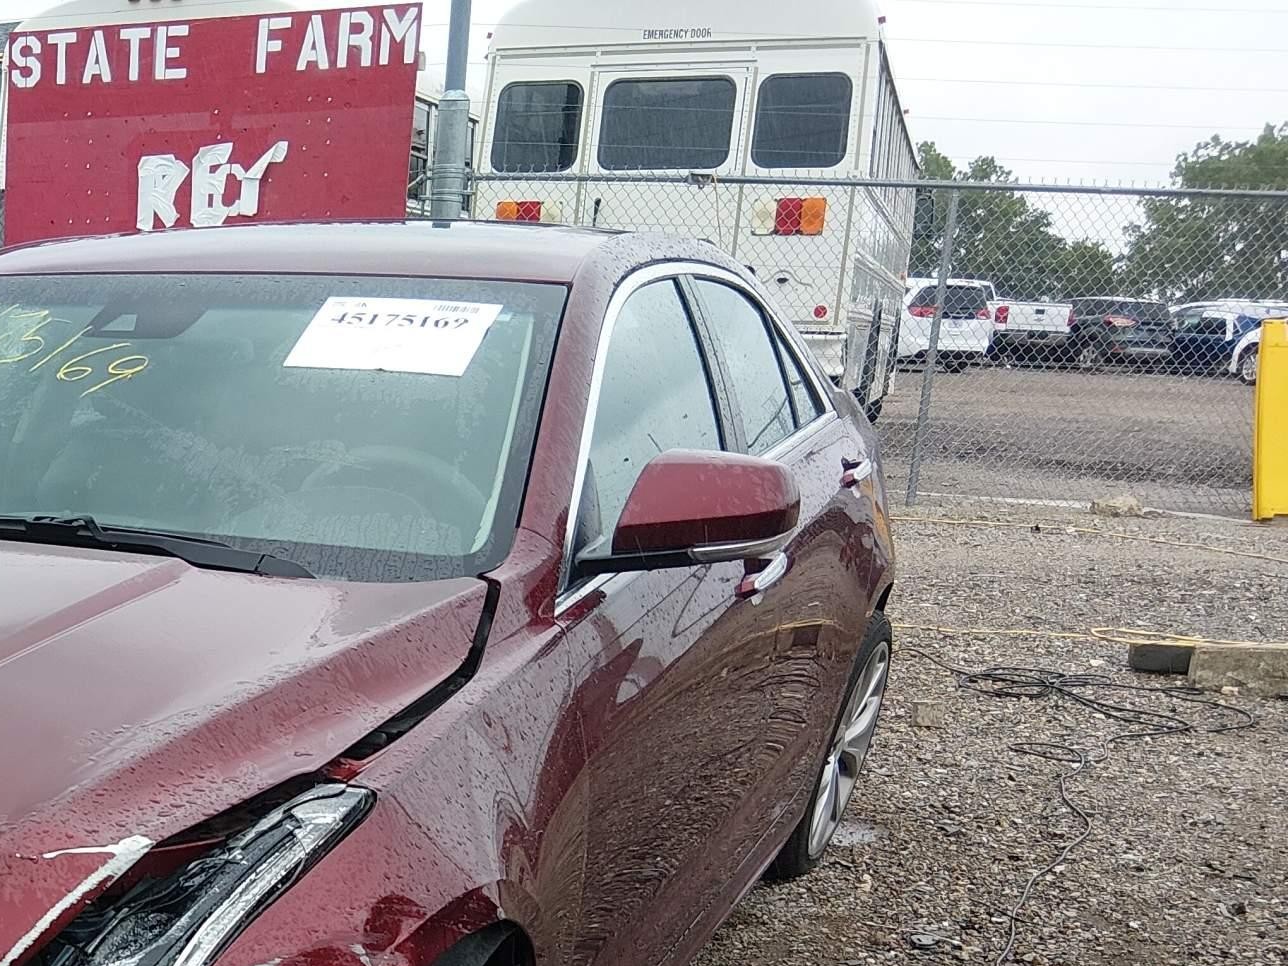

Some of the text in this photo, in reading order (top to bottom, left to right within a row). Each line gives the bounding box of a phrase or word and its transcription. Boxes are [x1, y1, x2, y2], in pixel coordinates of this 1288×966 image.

[643, 27, 712, 39] EMERGENCY DOOR
[11, 7, 418, 88] STATE FARM
[331, 312, 469, 329] 45175169
